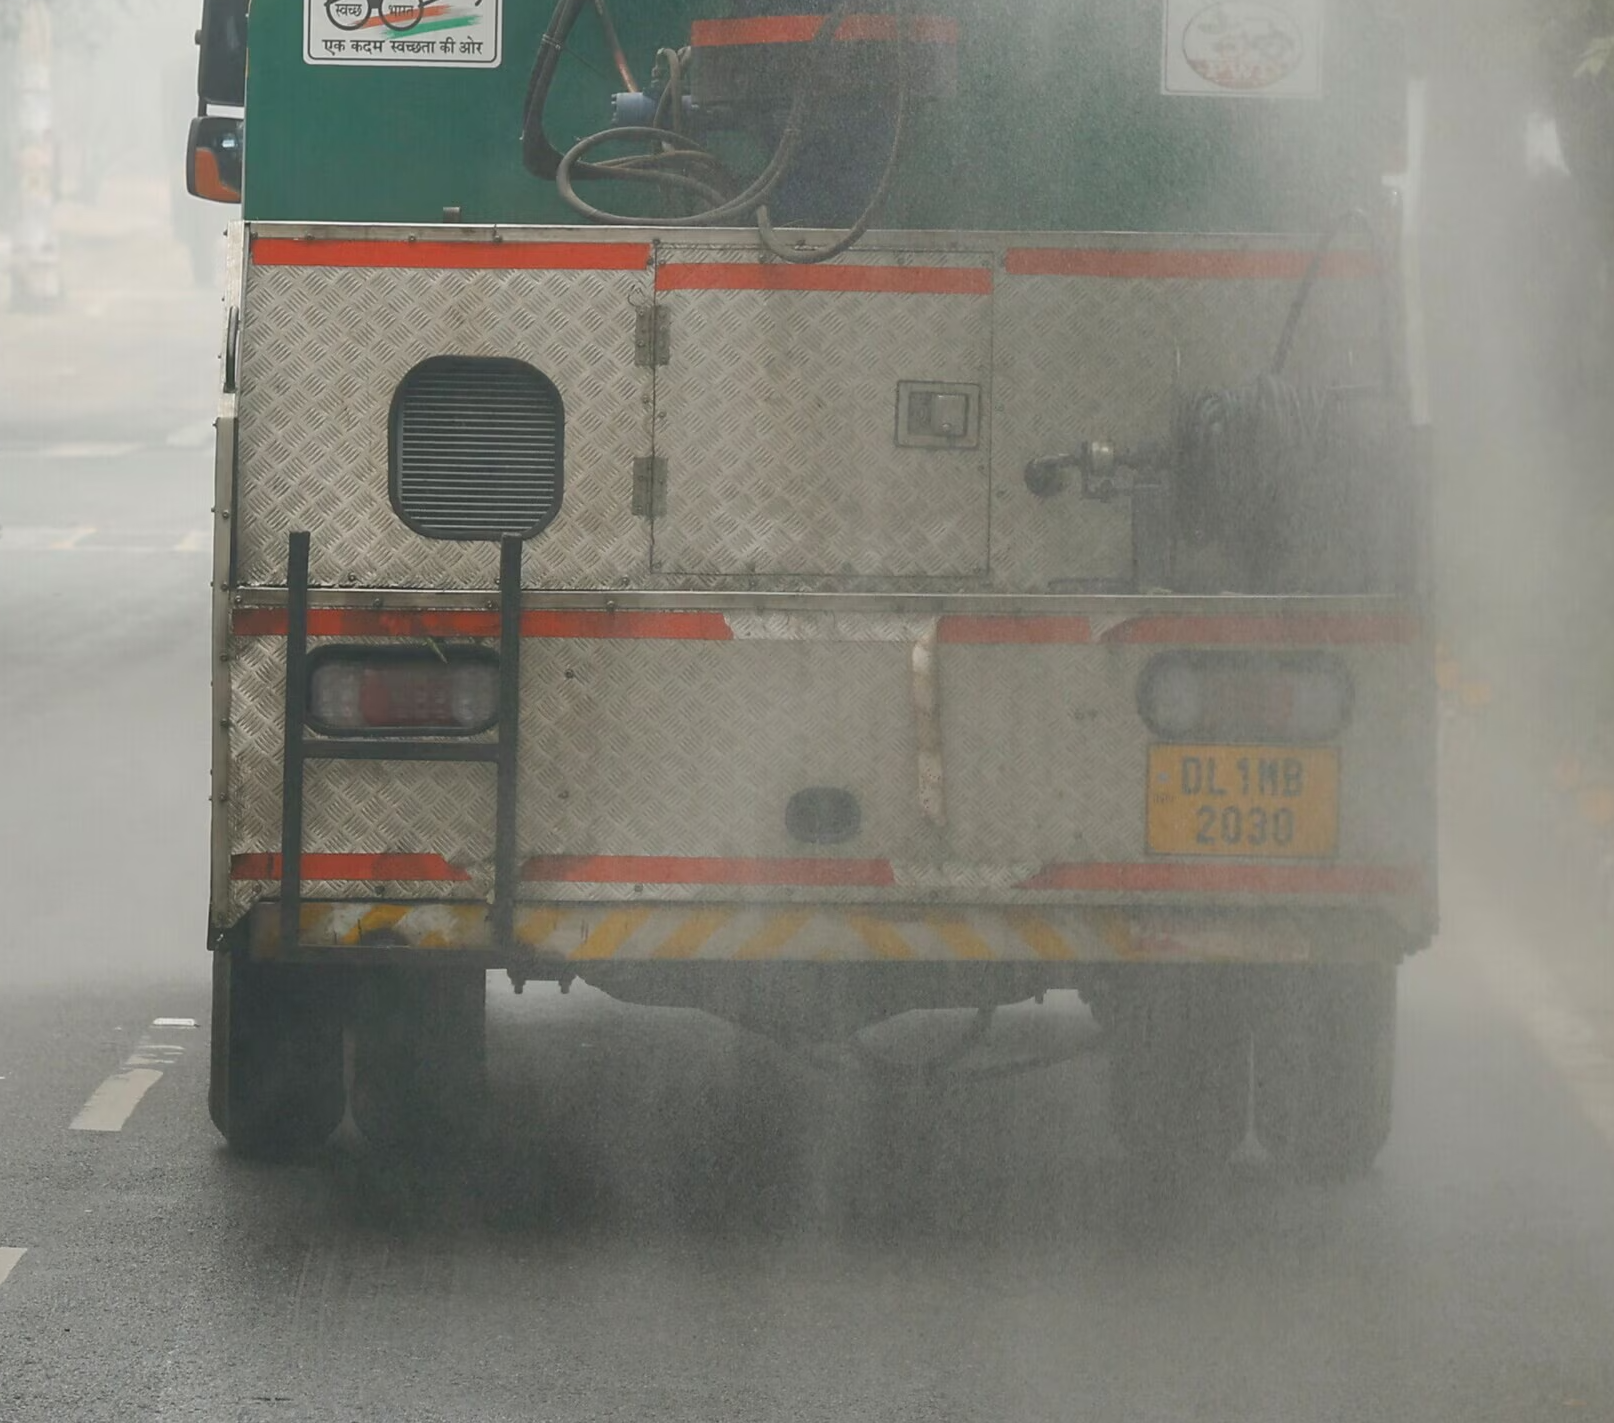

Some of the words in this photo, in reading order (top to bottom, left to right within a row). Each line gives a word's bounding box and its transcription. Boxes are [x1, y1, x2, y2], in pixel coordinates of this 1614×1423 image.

[335, 3, 362, 18] स्वच्छ
[388, 3, 414, 17] भारत
[322, 39, 345, 56] एक
[350, 39, 385, 55] कदम
[389, 40, 436, 55] स्वच्छता
[439, 36, 455, 55] की
[459, 36, 483, 55] ओर
[1196, 805, 1294, 846] 2030
